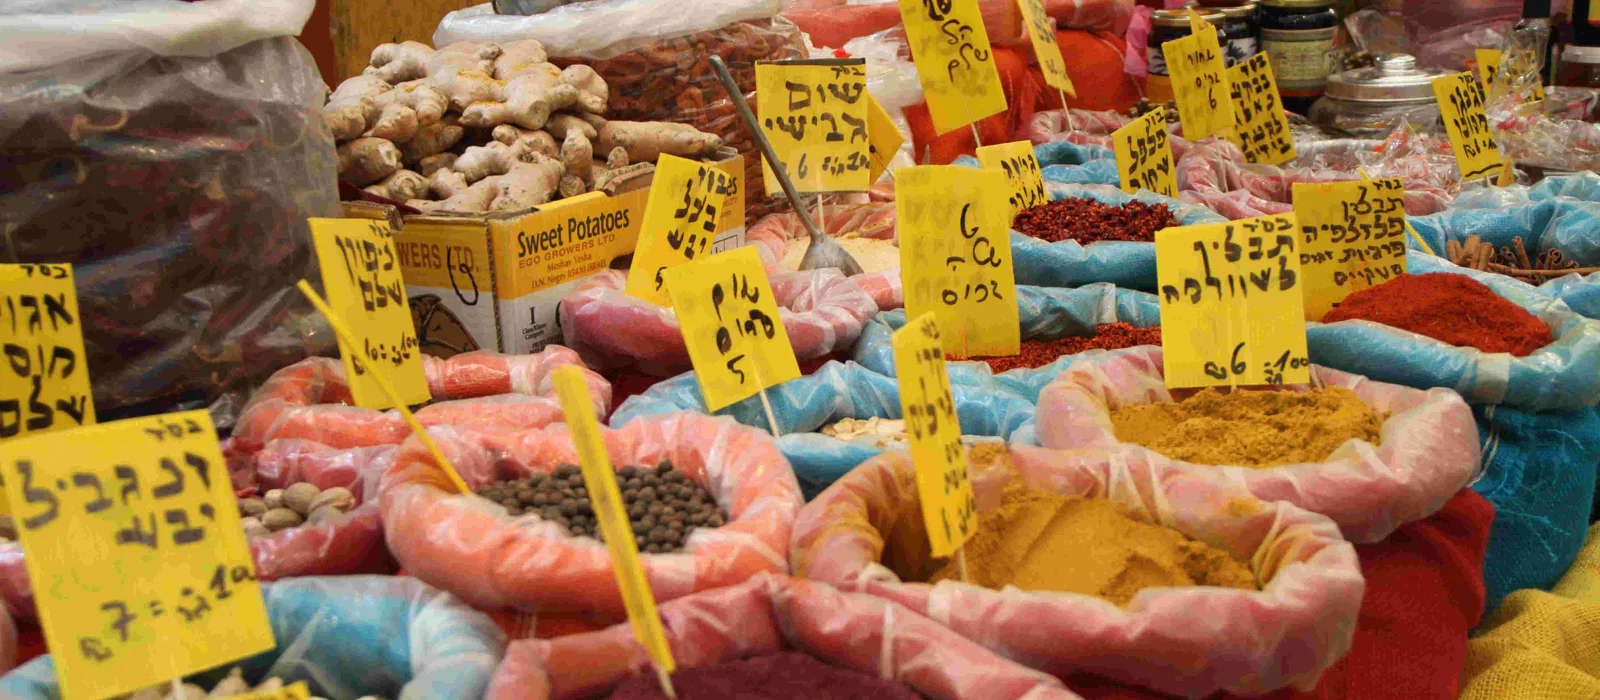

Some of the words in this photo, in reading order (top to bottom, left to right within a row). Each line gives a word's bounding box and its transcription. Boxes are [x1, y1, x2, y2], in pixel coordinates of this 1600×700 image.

[785, 80, 866, 112] שום
[765, 112, 868, 144] גבישי
[517, 223, 564, 258] Sweet
[567, 208, 630, 243] Potatoes
[1193, 226, 1294, 279] תבלין
[396, 241, 442, 270] WERS
[518, 256, 541, 269] EGO
[544, 240, 595, 261] GROWERS
[358, 272, 402, 312] שלם
[0, 293, 74, 336] אגו
[1231, 341, 1247, 375] 6
[0, 374, 87, 439] שלם
[15, 451, 212, 531] זנגביל
[115, 502, 215, 550] יבש
